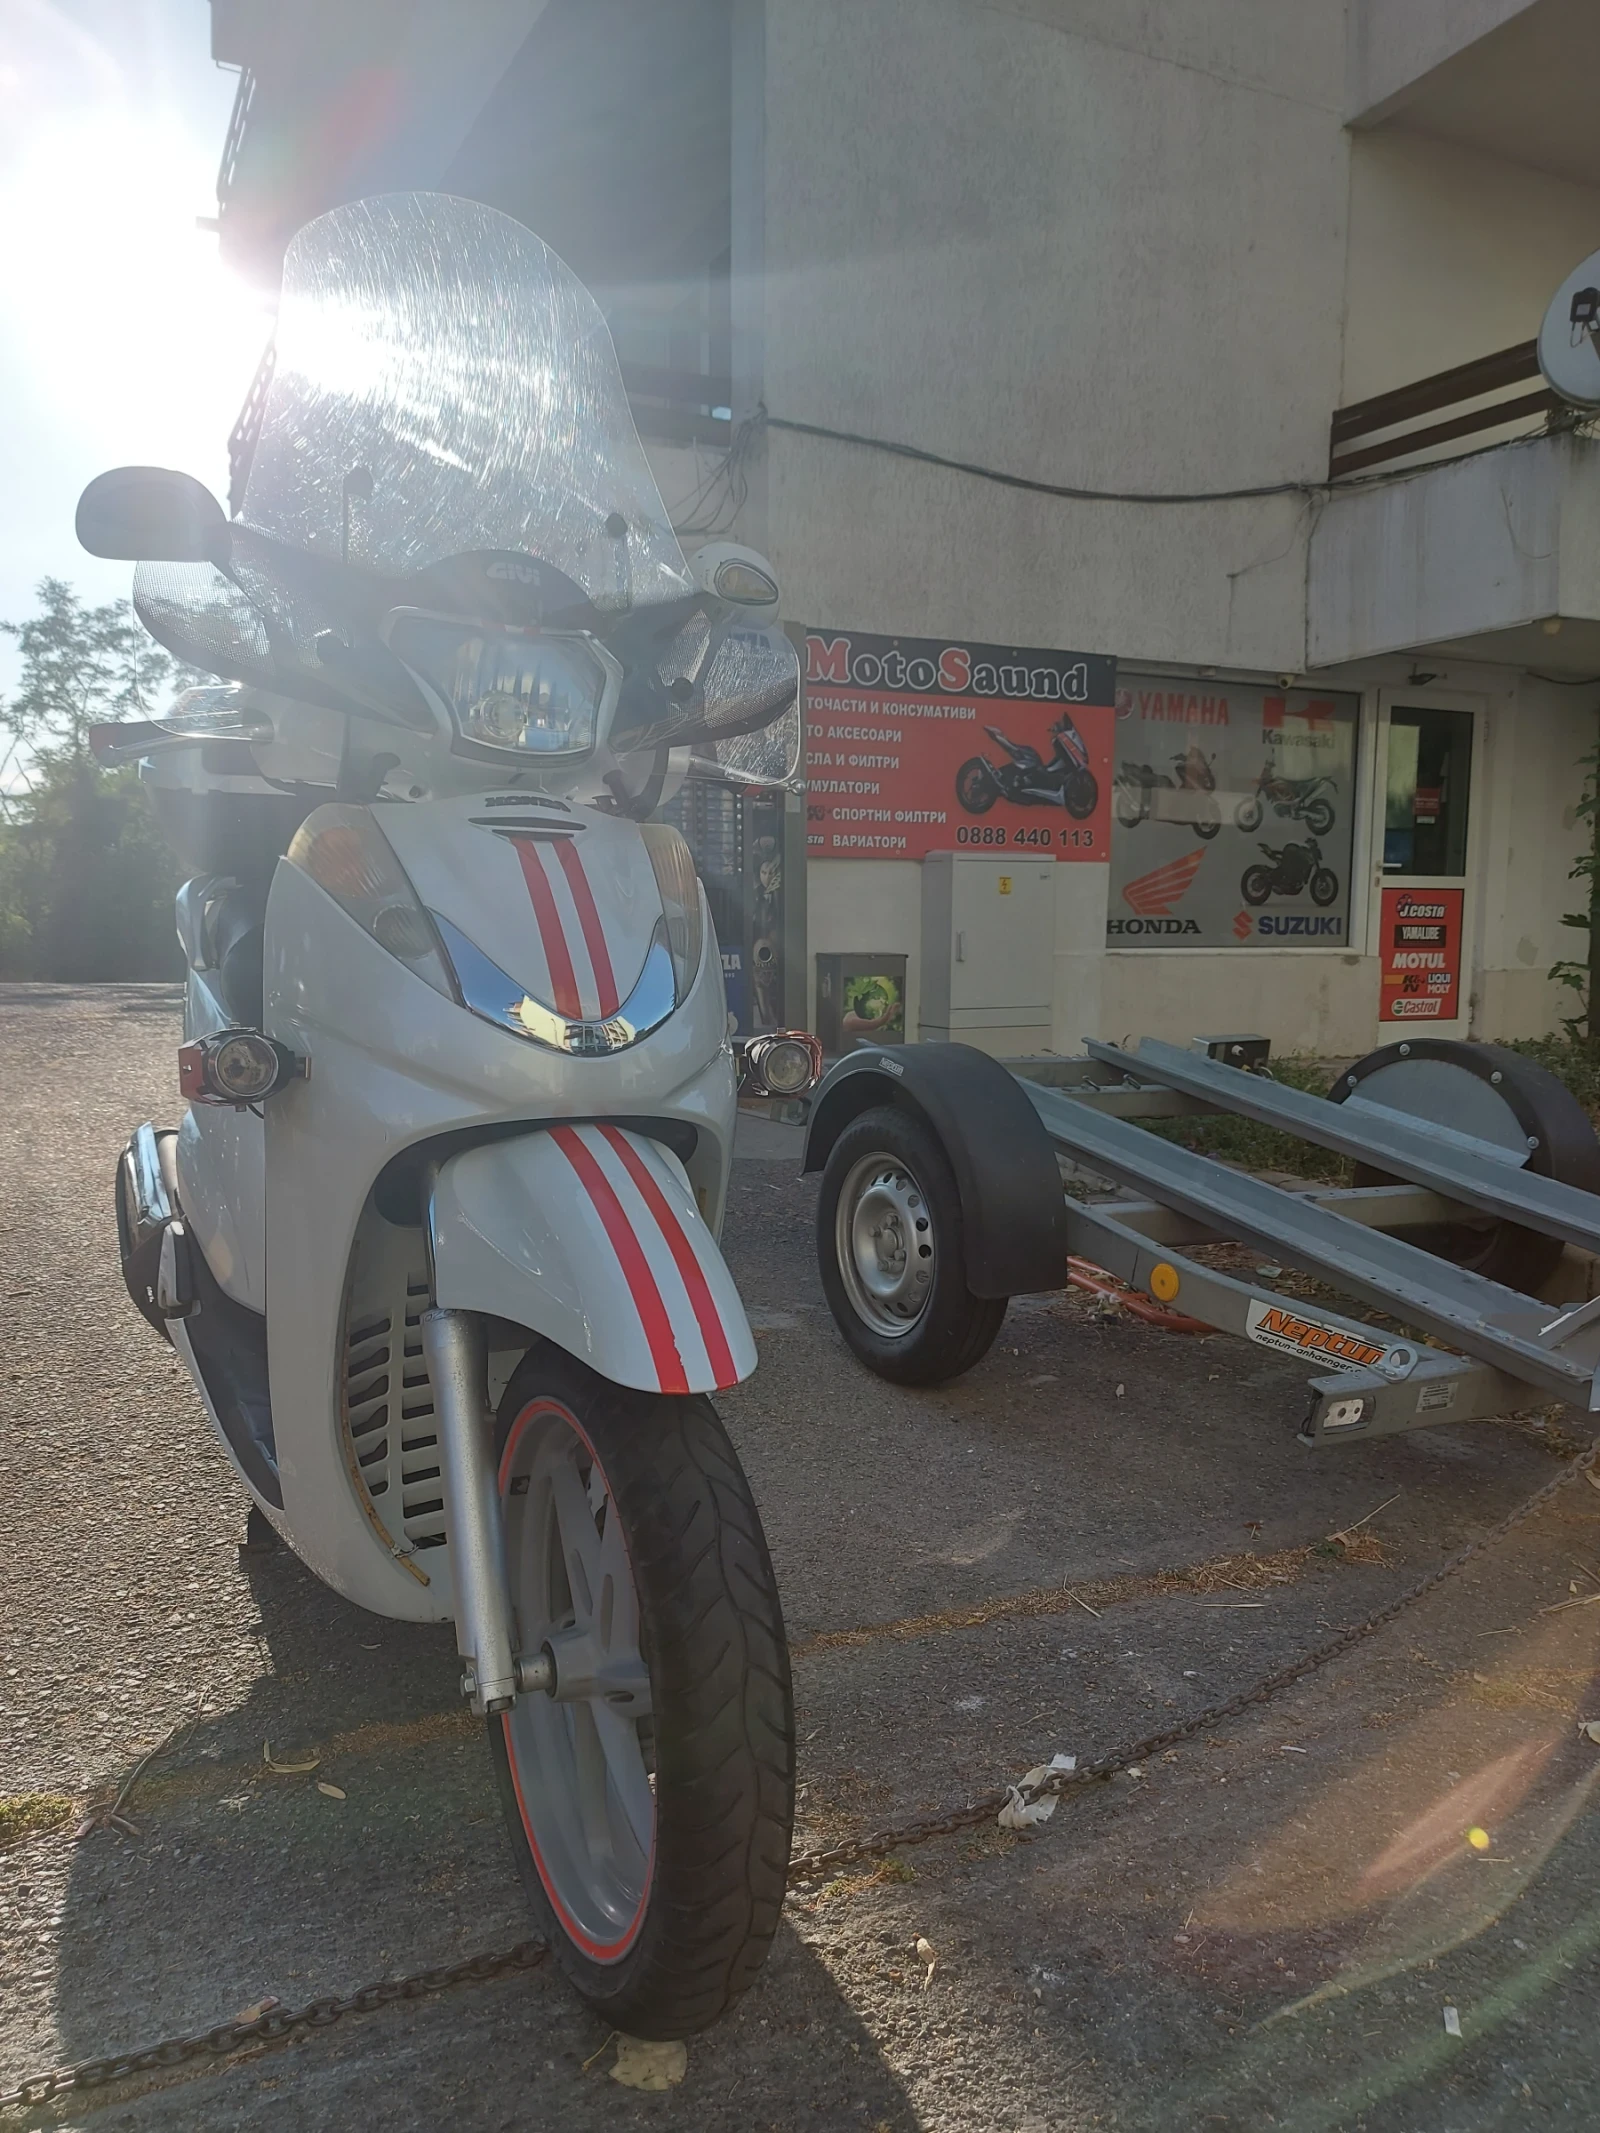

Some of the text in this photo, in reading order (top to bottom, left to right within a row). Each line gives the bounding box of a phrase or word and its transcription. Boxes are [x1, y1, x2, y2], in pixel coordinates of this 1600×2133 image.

[806, 635, 1088, 701] MotoSaund
[806, 697, 976, 720] ТОЧАСТИ И КОНСУМАТИВИ
[1138, 690, 1230, 726] YAMAHA
[827, 726, 902, 742] АКСЕСОАРИ
[1261, 729, 1336, 750] Kawasaki
[836, 753, 845, 766] И
[848, 754, 900, 769] ФИЛТРИ
[832, 807, 891, 822] СПОРТНИ
[895, 810, 947, 824] ФИЛТРИ
[832, 834, 907, 849] ВАРИАТОРИ
[956, 826, 1094, 847] 0888 440 113
[1400, 905, 1446, 918] J.COSTA
[1106, 918, 1202, 935] HONDA
[1258, 916, 1342, 936] SUZUKI
[1391, 952, 1446, 969] MOTUL
[1427, 973, 1452, 984] LIQUI
[1427, 984, 1452, 994] MOLY
[1403, 1000, 1438, 1014] Castrol
[1257, 1308, 1385, 1365] Neptun
